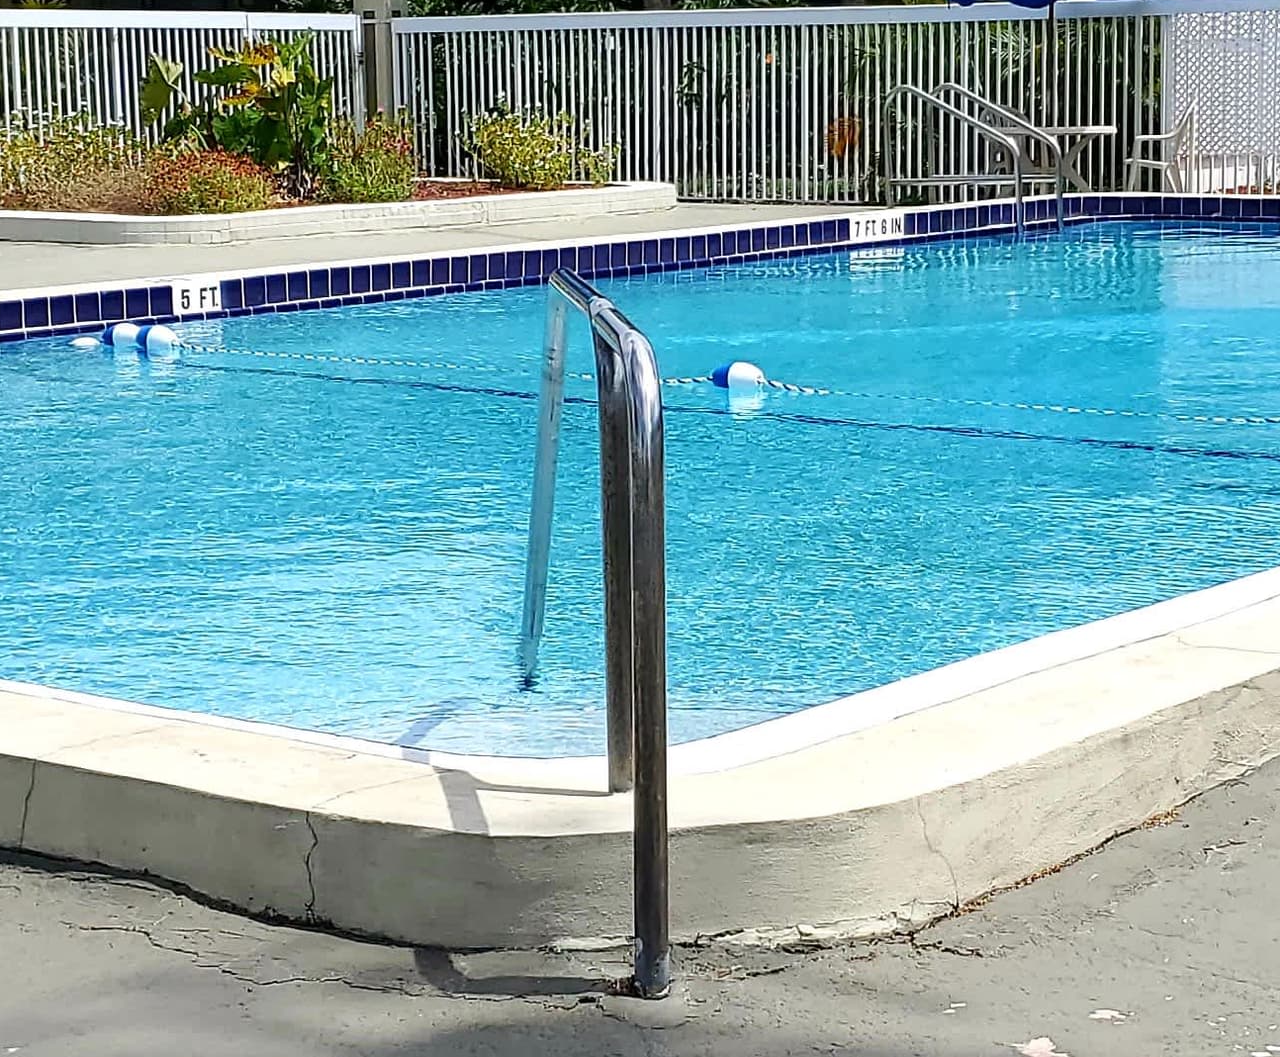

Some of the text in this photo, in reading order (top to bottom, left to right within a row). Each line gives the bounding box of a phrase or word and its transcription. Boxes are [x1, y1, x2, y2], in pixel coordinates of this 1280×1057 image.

[855, 220, 861, 237] 7
[181, 286, 219, 310] 5 FT.
